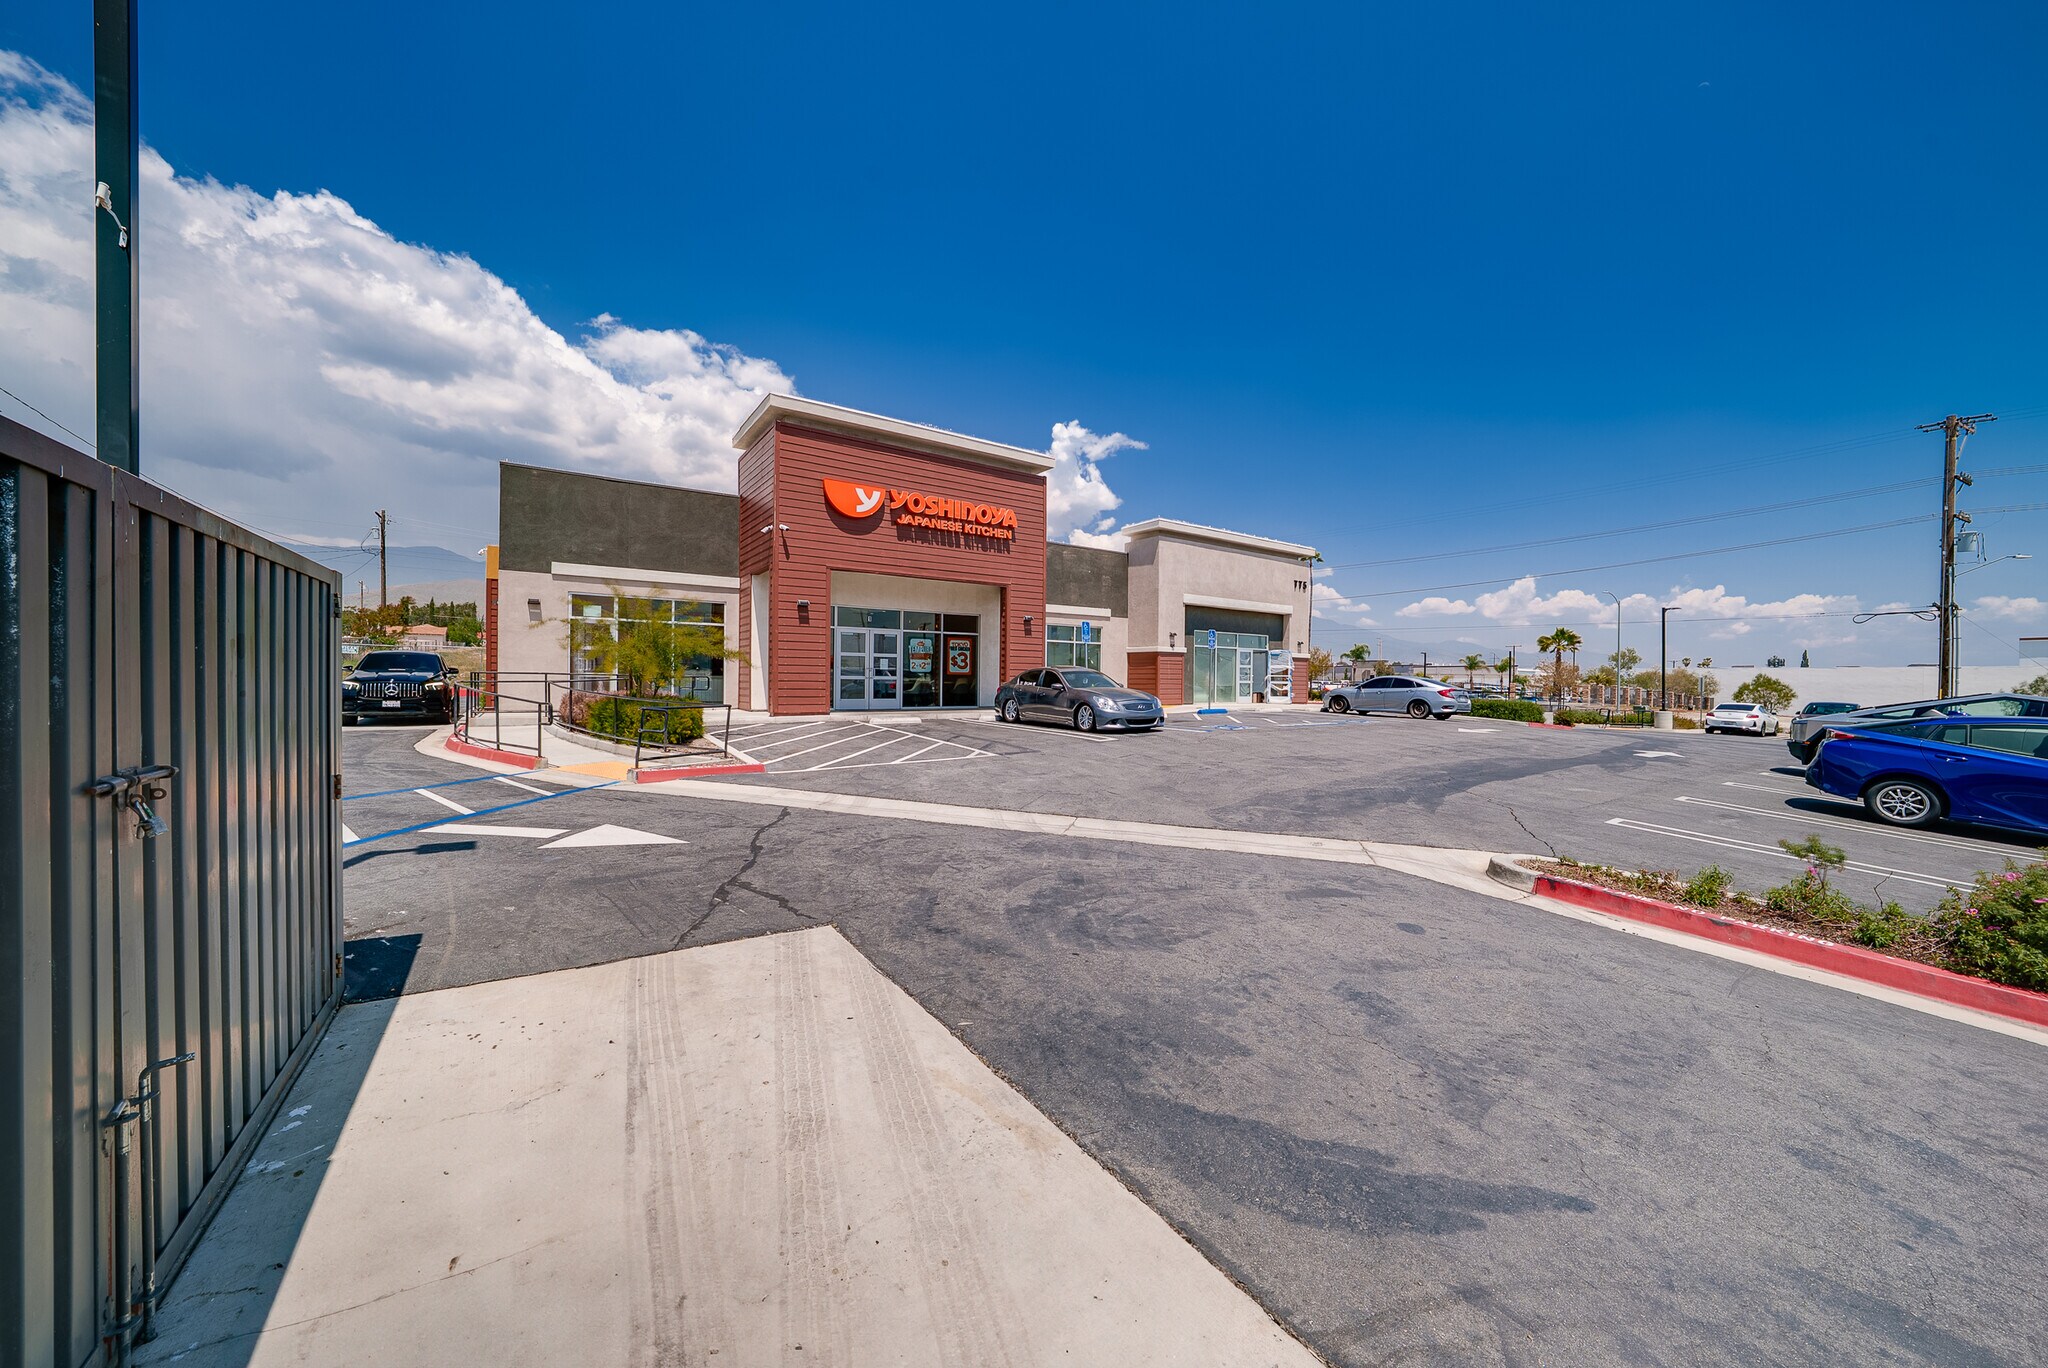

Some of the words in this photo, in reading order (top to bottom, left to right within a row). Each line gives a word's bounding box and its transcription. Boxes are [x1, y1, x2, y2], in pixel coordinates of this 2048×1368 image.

[889, 489, 1018, 528] YOSHINOYA
[897, 514, 963, 532] JAPANESE
[964, 523, 1013, 540] KITCHEN
[951, 652, 969, 670] $3
[1674, 905, 1706, 915] NO
[1720, 915, 1835, 947] PARKING
